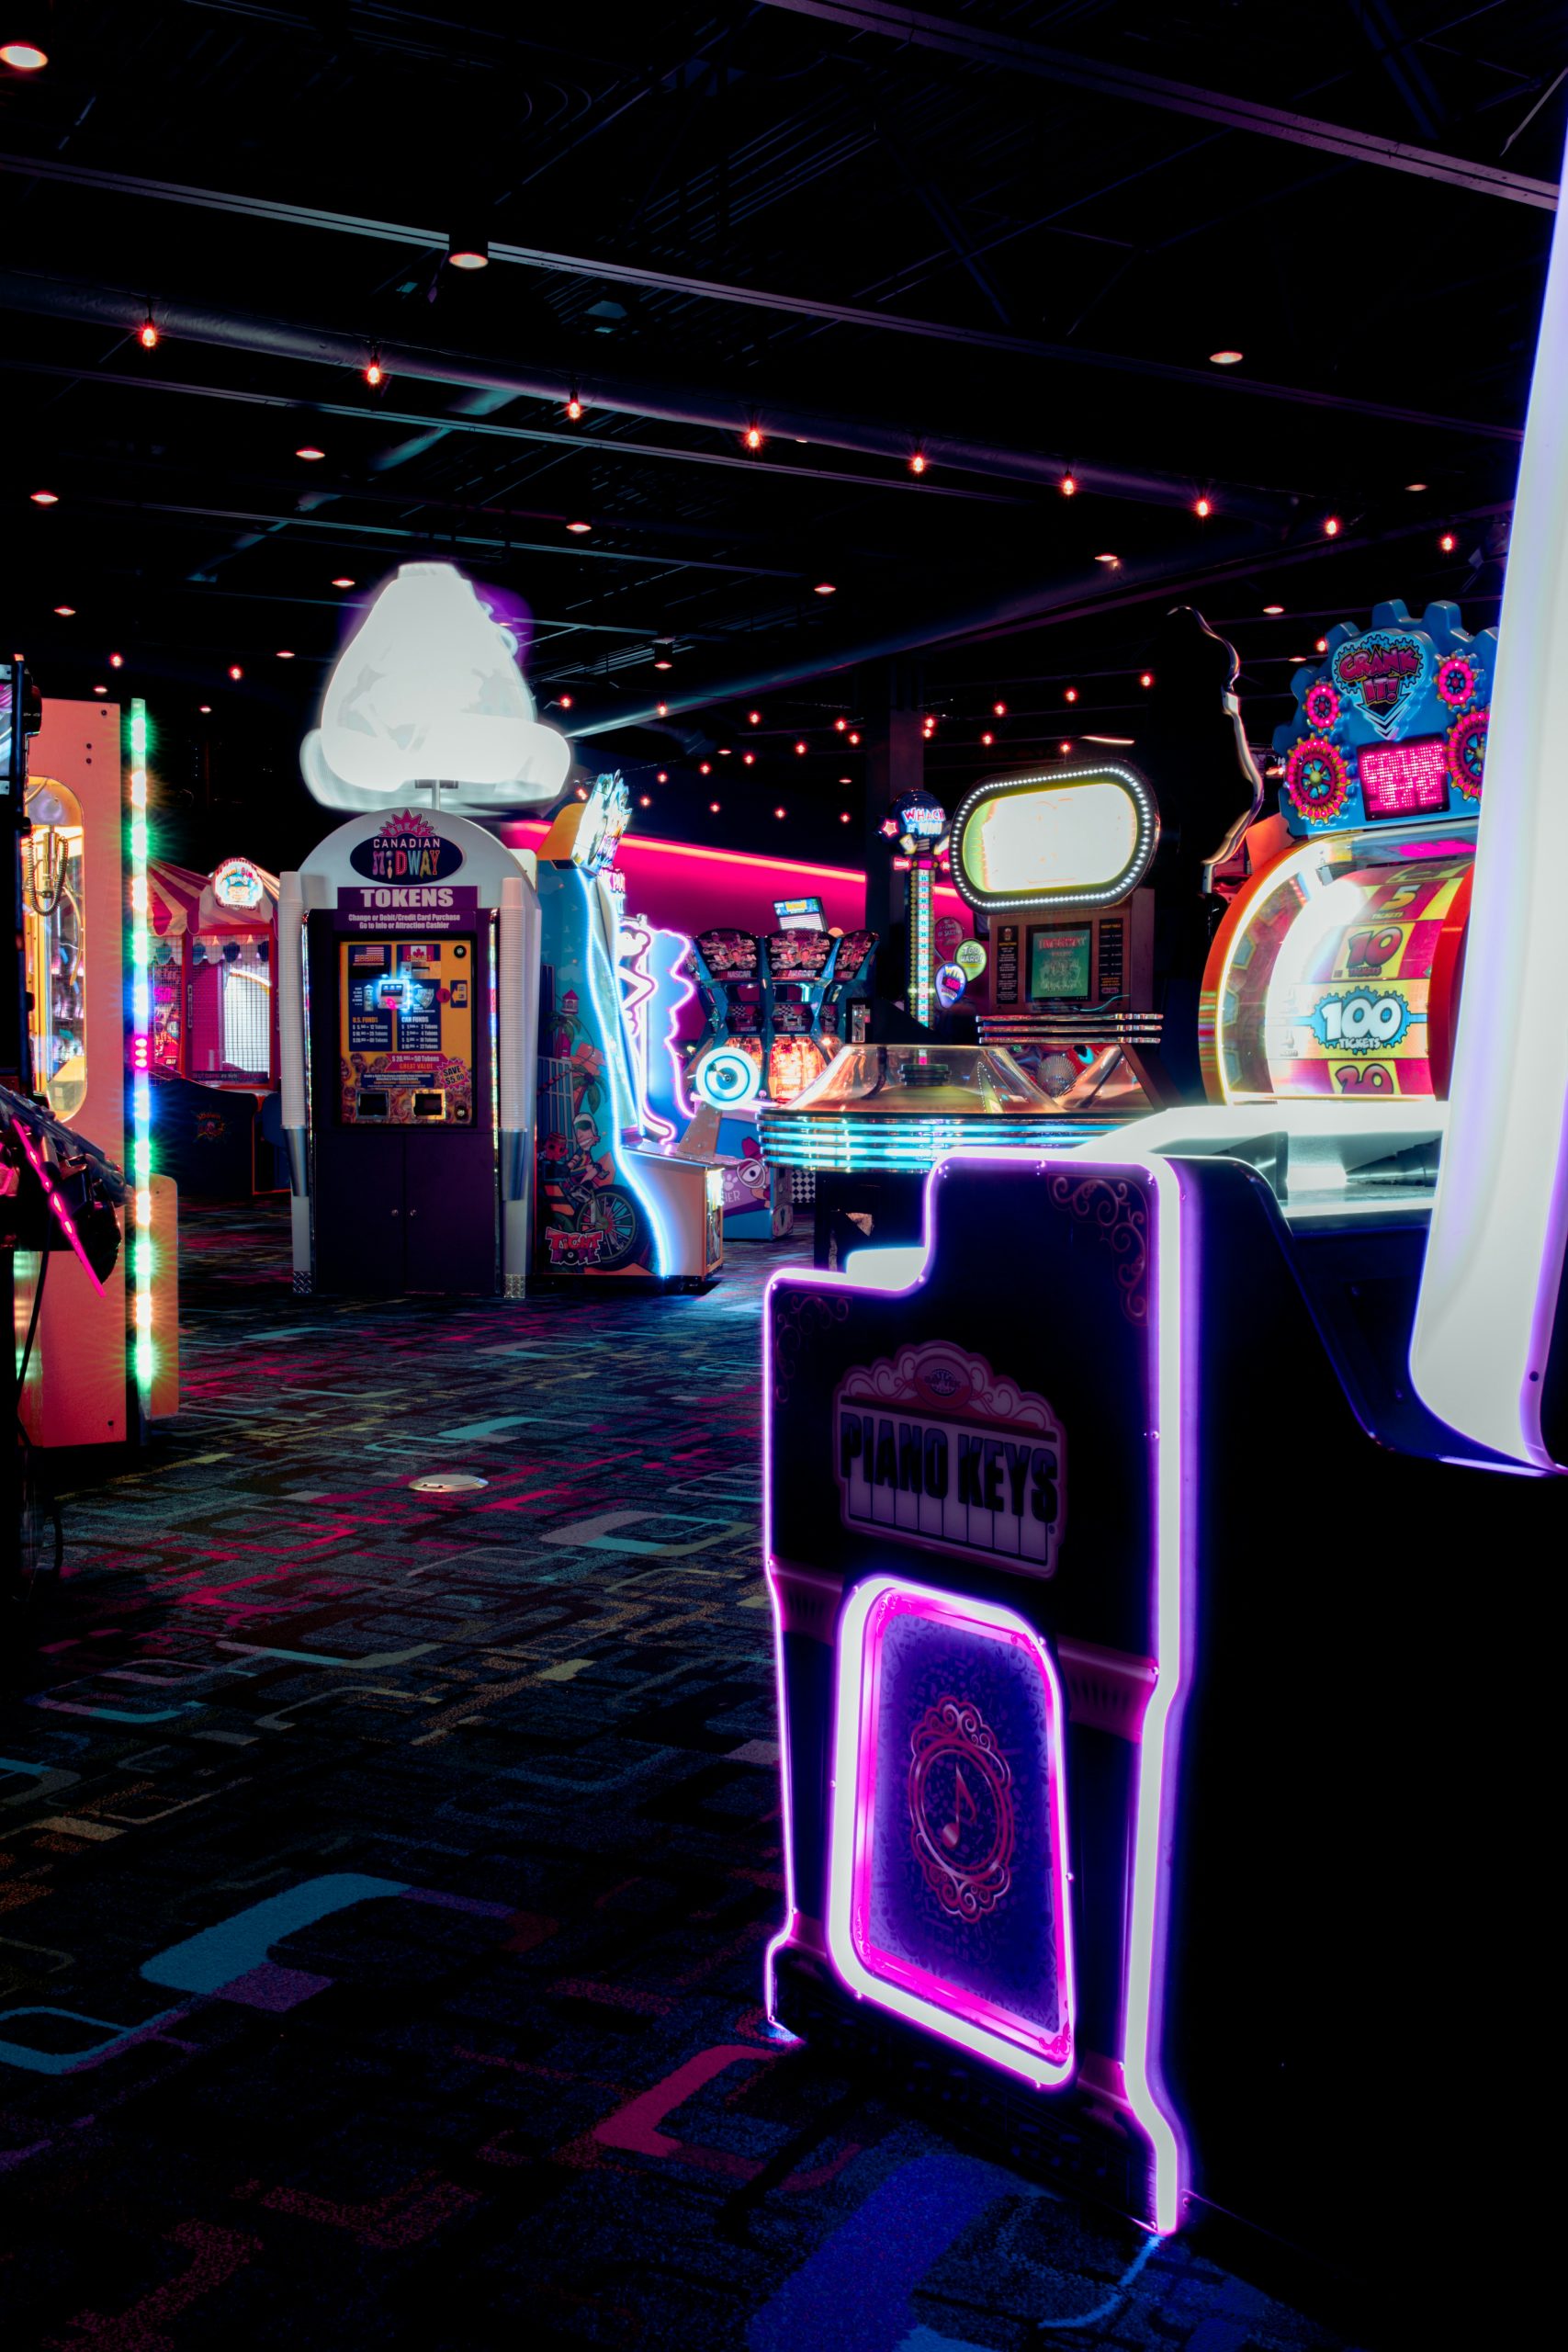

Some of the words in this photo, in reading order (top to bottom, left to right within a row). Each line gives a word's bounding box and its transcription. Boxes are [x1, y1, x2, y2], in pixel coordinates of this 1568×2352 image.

[1339, 645, 1418, 681] CRANK
[1363, 678, 1399, 702] IT!
[902, 808, 945, 822] WHACK
[373, 838, 441, 849] CANADIAN
[360, 888, 454, 908] TOKENS
[1380, 884, 1422, 911] 5
[348, 913, 371, 922] Change
[379, 913, 416, 922] Debit/Credit
[417, 913, 432, 922] Card
[432, 913, 461, 922] Purchase
[963, 945, 980, 955] TOO
[1347, 926, 1404, 968] 10
[961, 953, 985, 964] HARD!
[1321, 997, 1403, 1042] 100
[1338, 1037, 1382, 1049] TICKETS
[443, 1065, 462, 1076] SAVE
[446, 1073, 465, 1085] $5.00
[1335, 1064, 1394, 1093] 20
[840, 1411, 949, 1499] PIANO
[957, 1433, 1058, 1523] KEYS
